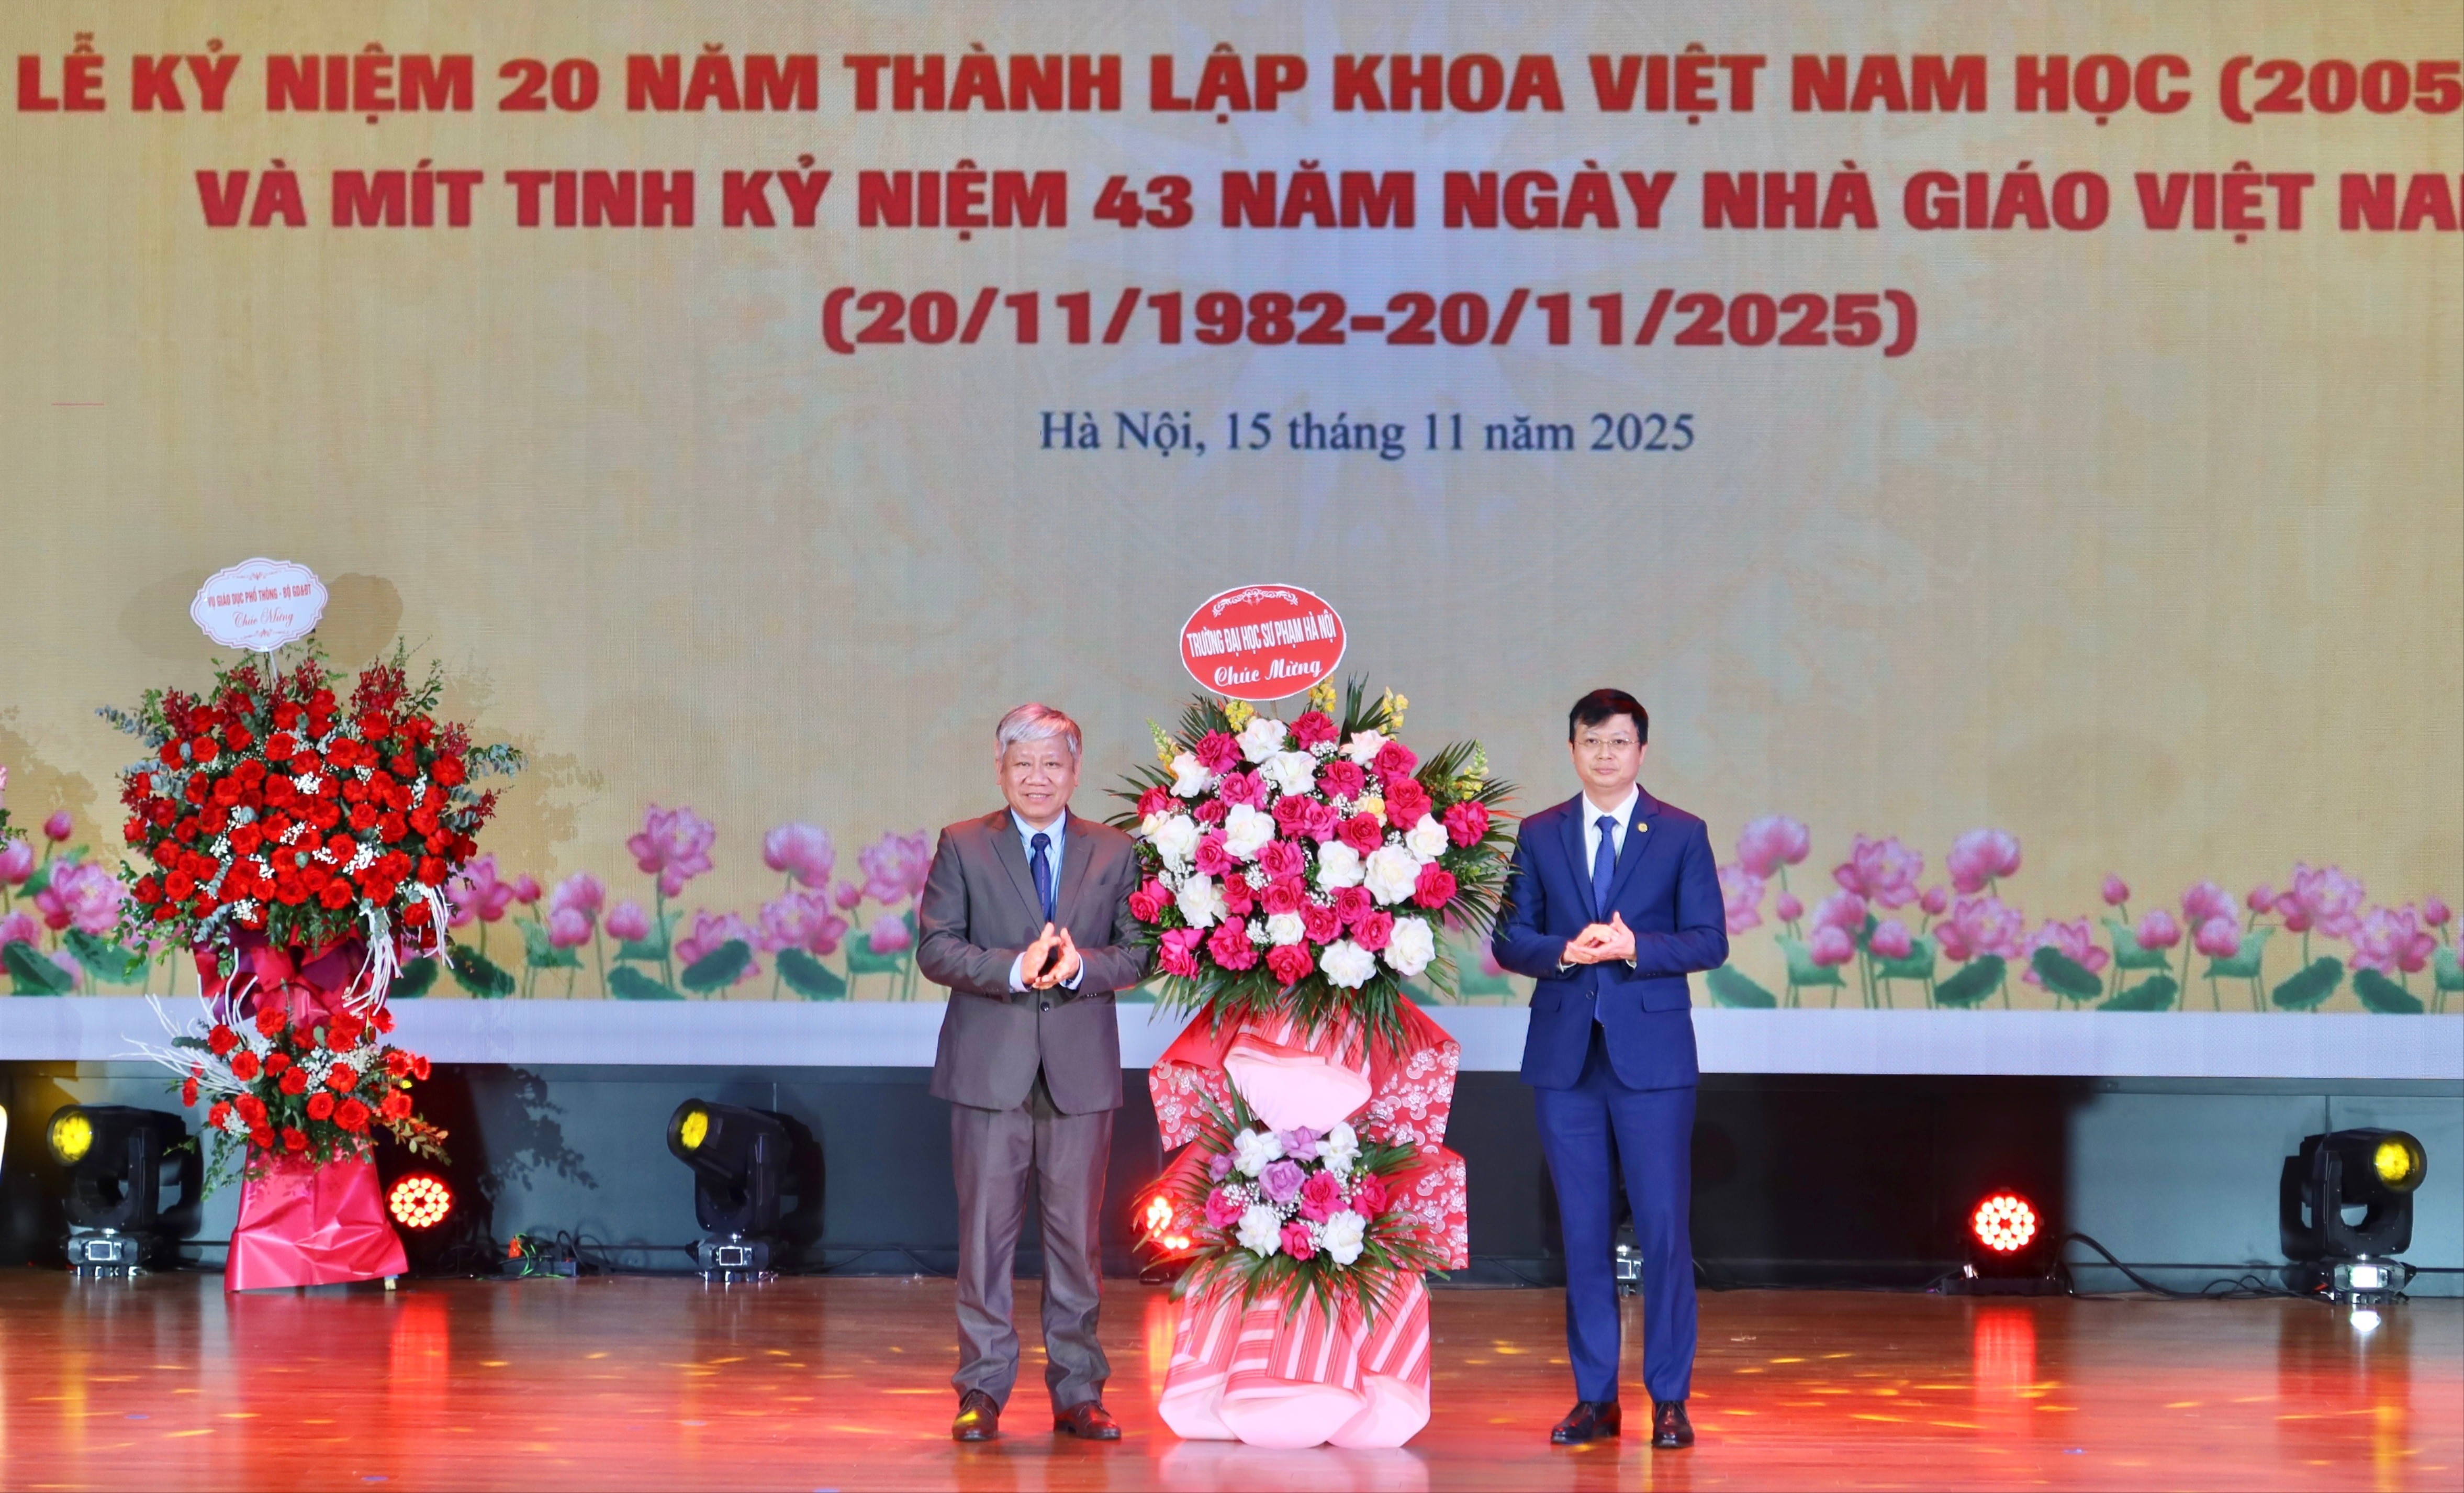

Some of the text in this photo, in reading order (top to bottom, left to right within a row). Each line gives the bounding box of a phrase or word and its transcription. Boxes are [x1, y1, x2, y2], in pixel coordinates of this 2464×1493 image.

[17, 31, 2463, 125] LỄ KỶ NIỆM 20 NĂM THÀNH LẬP KHOA VIỆT NAM HỌC (2005
[196, 154, 2463, 243] VÀ MÍT TINH KỶ NIỆM 43 NĂM NGÀY NHÀ GIÁO VIỆT NA
[823, 287, 1918, 356] (20/11/1982-20/11/2025)
[1039, 410, 1695, 462] Hà Nội, 15 tháng 11 năm 2025
[1186, 609, 1337, 658] TRƯỜNG ĐẠI HỌC SƯ PHẠM HÀ NỘI
[1214, 658, 1323, 687] Chúc Mừng
